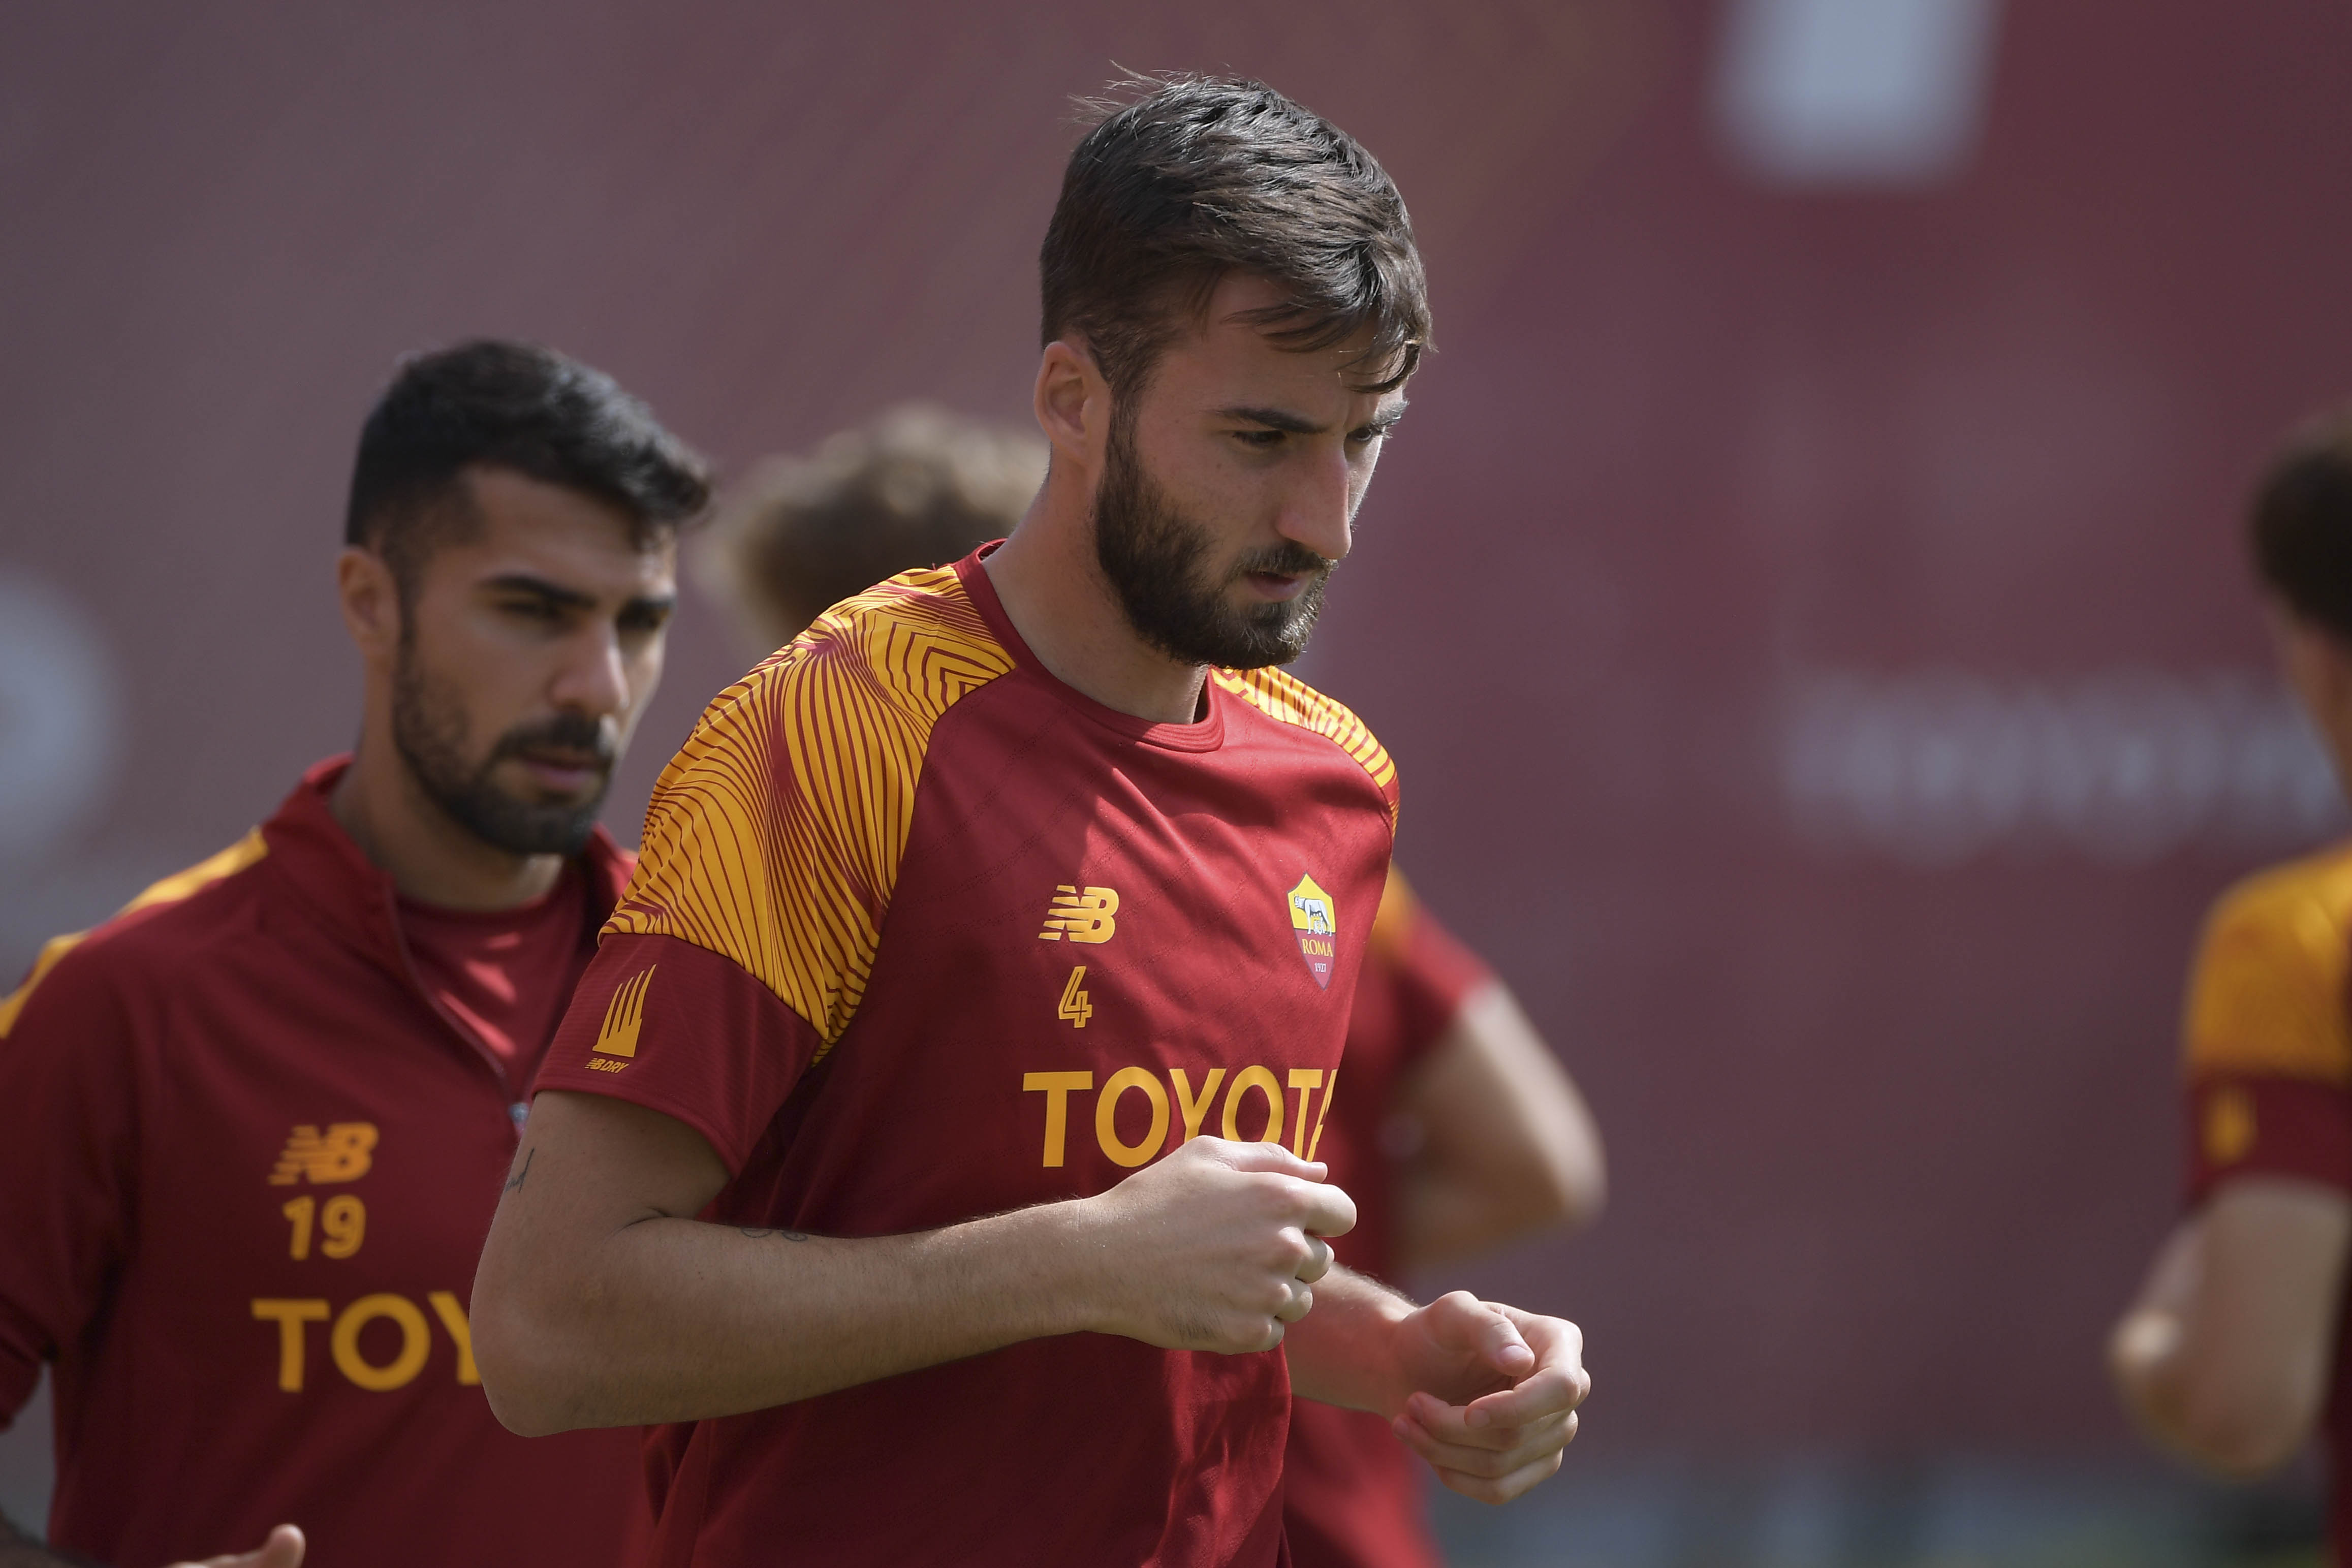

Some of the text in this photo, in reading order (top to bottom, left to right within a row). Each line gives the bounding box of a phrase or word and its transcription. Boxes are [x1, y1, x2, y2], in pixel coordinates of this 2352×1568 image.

[1039, 885, 1120, 944] NB
[1302, 938, 1333, 957] ROMA
[1314, 963, 1326, 972] 1927
[1058, 966, 1092, 1028] 4
[268, 1123, 379, 1185] NB
[283, 1195, 366, 1260] 19
